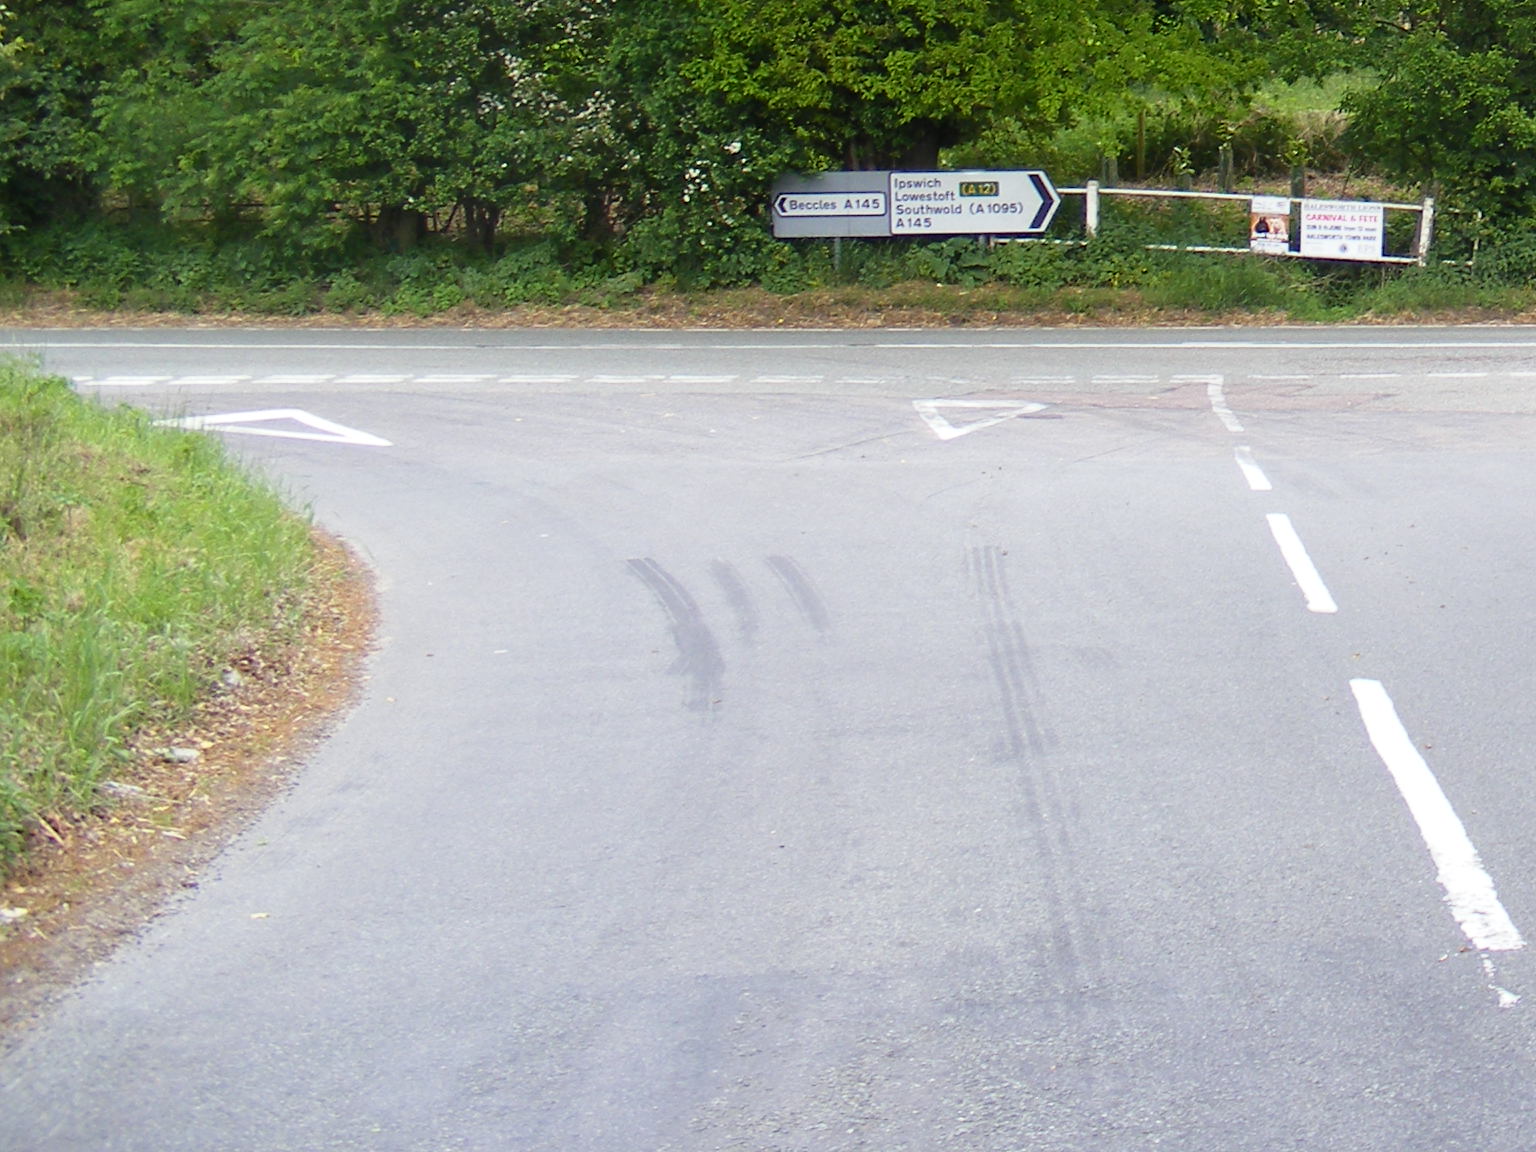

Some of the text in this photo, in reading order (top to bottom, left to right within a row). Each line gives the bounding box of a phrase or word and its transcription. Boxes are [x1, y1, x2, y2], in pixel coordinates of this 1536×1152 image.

[894, 178, 942, 189] Ipswich
[895, 191, 956, 202] Lowestoft
[789, 198, 880, 210] Beccles A145
[896, 204, 962, 215] Southwold
[896, 217, 932, 228] A145
[1306, 213, 1347, 222] CARNIVAL
